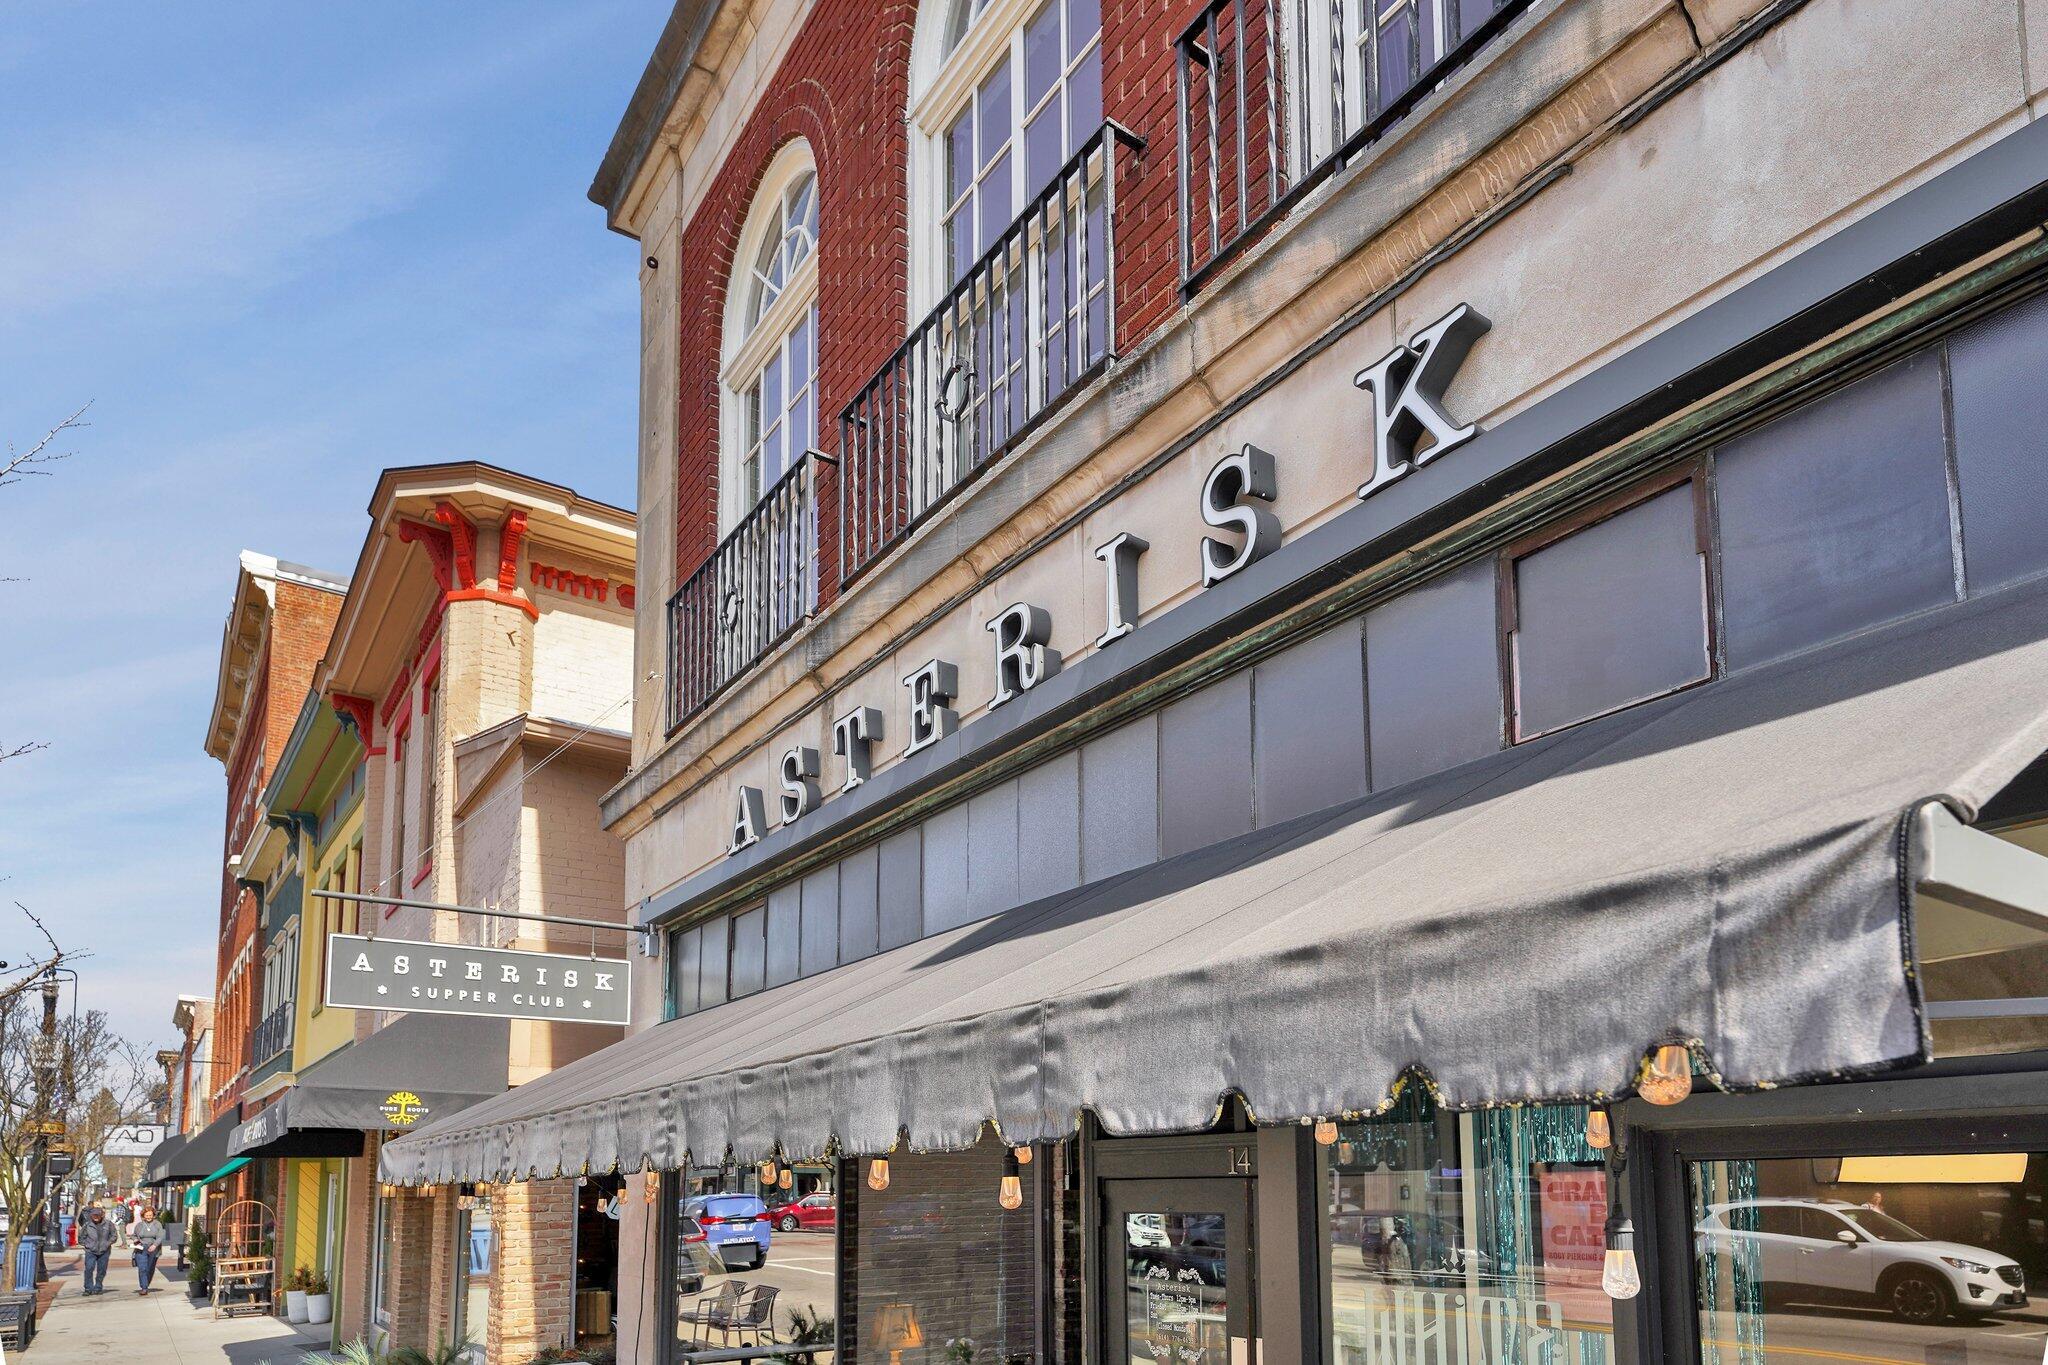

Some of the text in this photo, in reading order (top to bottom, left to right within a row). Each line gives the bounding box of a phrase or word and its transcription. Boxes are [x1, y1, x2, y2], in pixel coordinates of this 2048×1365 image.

[727, 302, 1491, 857] ASTERISK
[351, 952, 614, 991] ASTERISK
[411, 986, 565, 1008] SUPPER CLUB
[407, 1106, 429, 1114] ROOTS
[1228, 1147, 1251, 1175] 14
[1156, 1282, 1191, 1293] Asterisk
